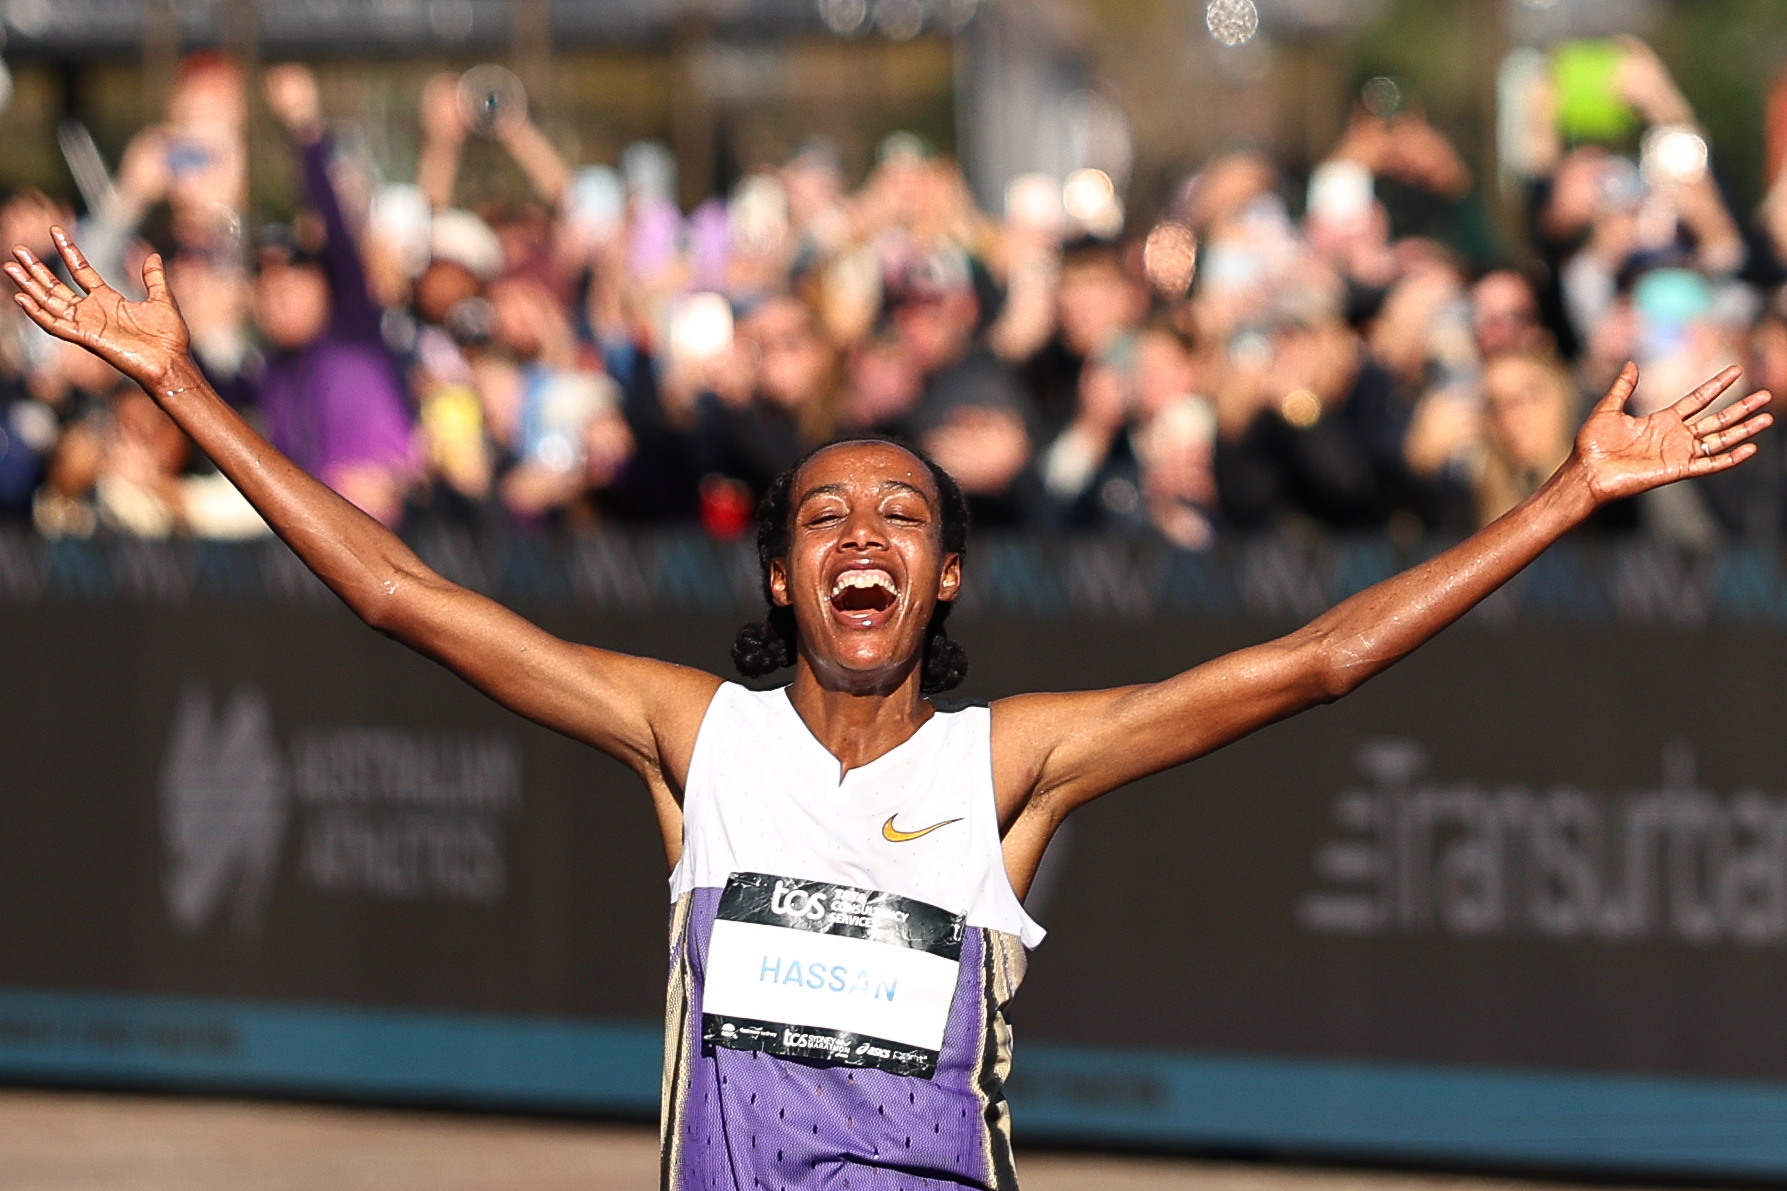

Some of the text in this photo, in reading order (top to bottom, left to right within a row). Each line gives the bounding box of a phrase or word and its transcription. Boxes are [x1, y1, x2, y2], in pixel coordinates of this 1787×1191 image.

[833, 888, 868, 904] TATA
[828, 911, 881, 928] SERVICE
[759, 955, 898, 1002] HASSAN
